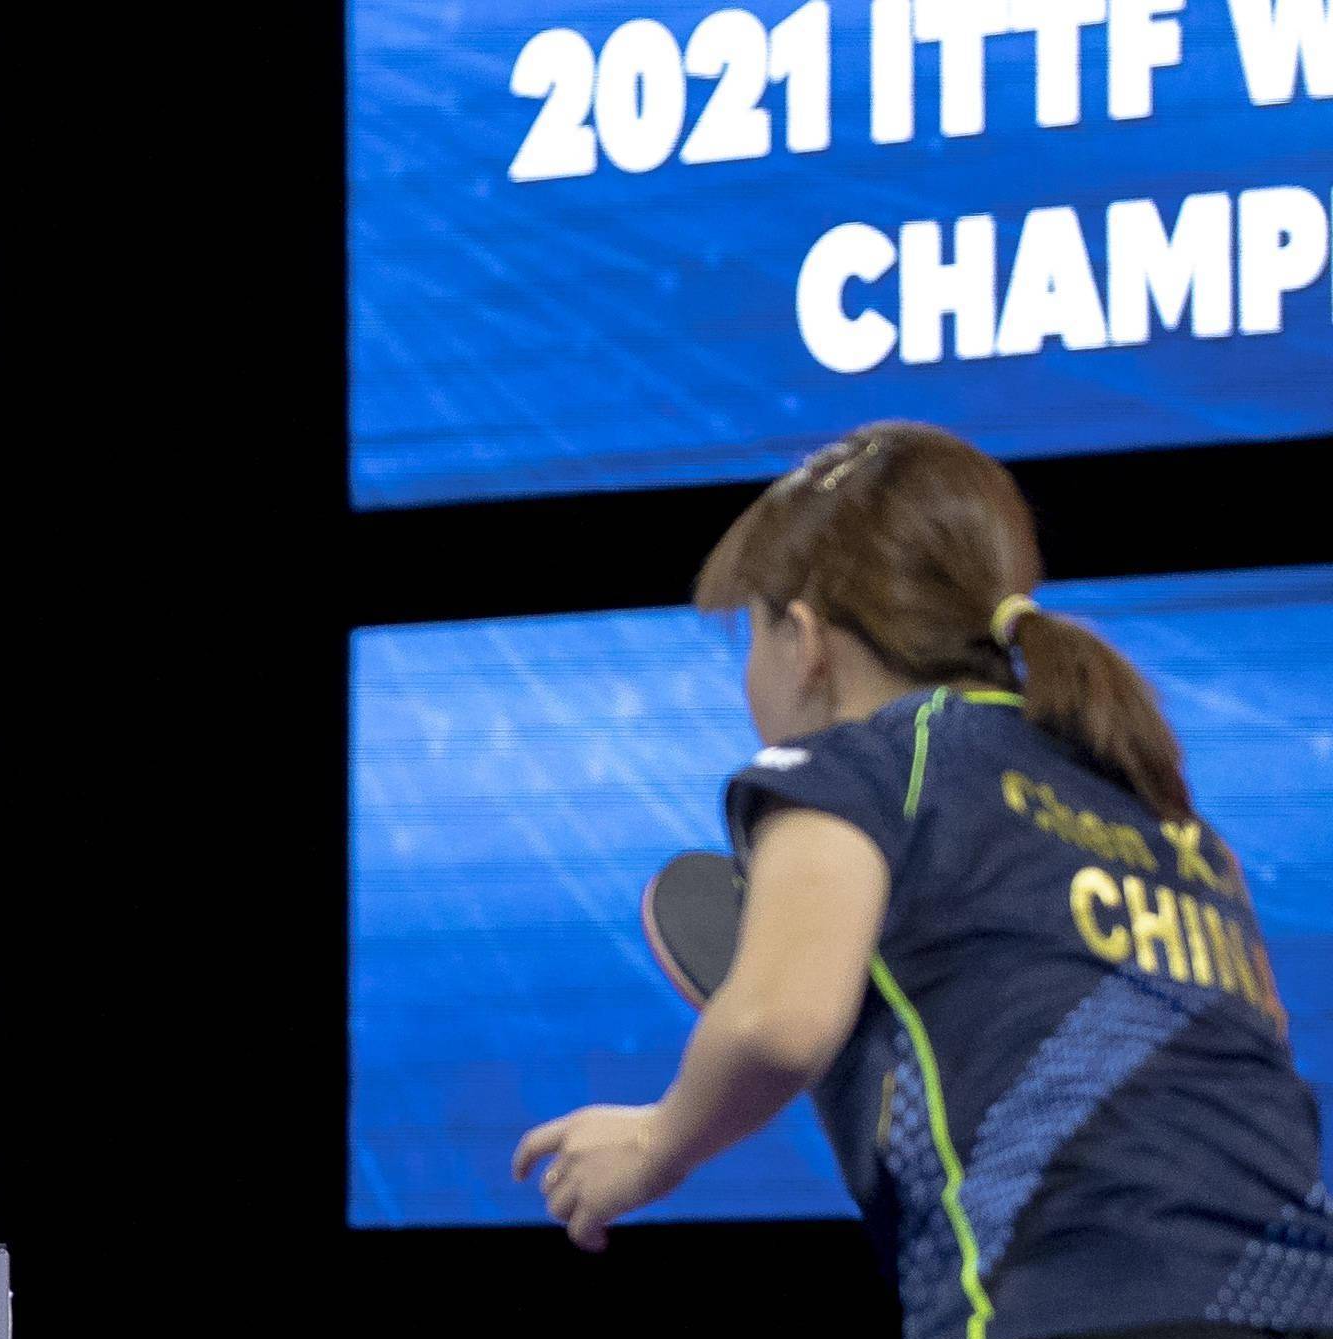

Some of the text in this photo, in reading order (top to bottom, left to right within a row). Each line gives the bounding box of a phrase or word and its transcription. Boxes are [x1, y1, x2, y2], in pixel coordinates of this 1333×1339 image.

[509, 0, 830, 183] 2021
[871, 0, 1186, 145] ITTF
[796, 186, 1333, 373] CHAMP
[1069, 866, 1273, 1012] CHIN
